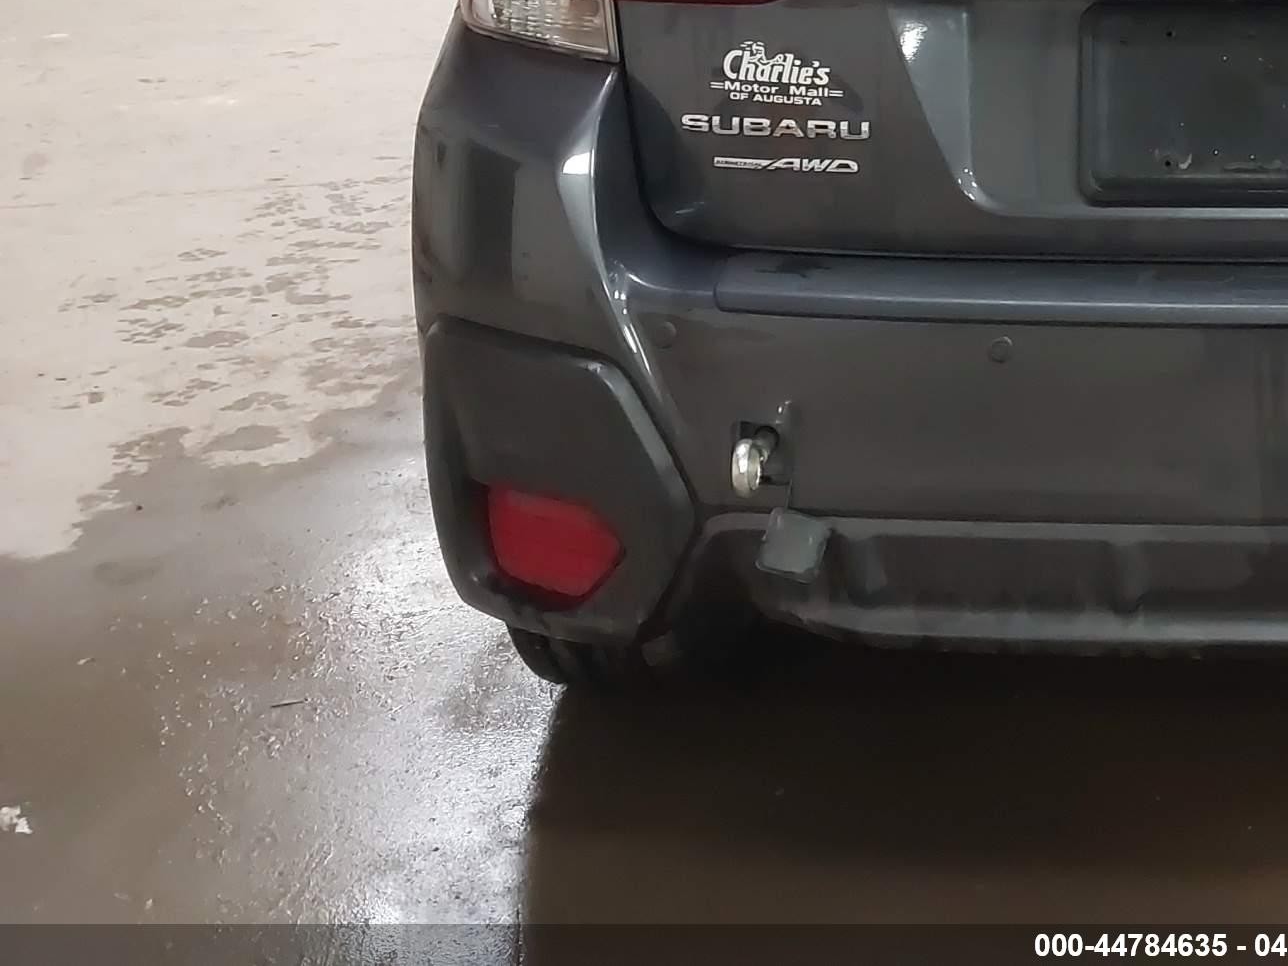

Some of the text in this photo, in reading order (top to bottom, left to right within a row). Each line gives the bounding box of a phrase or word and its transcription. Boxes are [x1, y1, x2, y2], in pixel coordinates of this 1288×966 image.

[723, 49, 830, 85] Charlie's
[724, 81, 829, 98] Motor Mall
[729, 91, 822, 106] OF AUGUSTA
[681, 114, 869, 140] SUBARU
[767, 157, 858, 172] AWD
